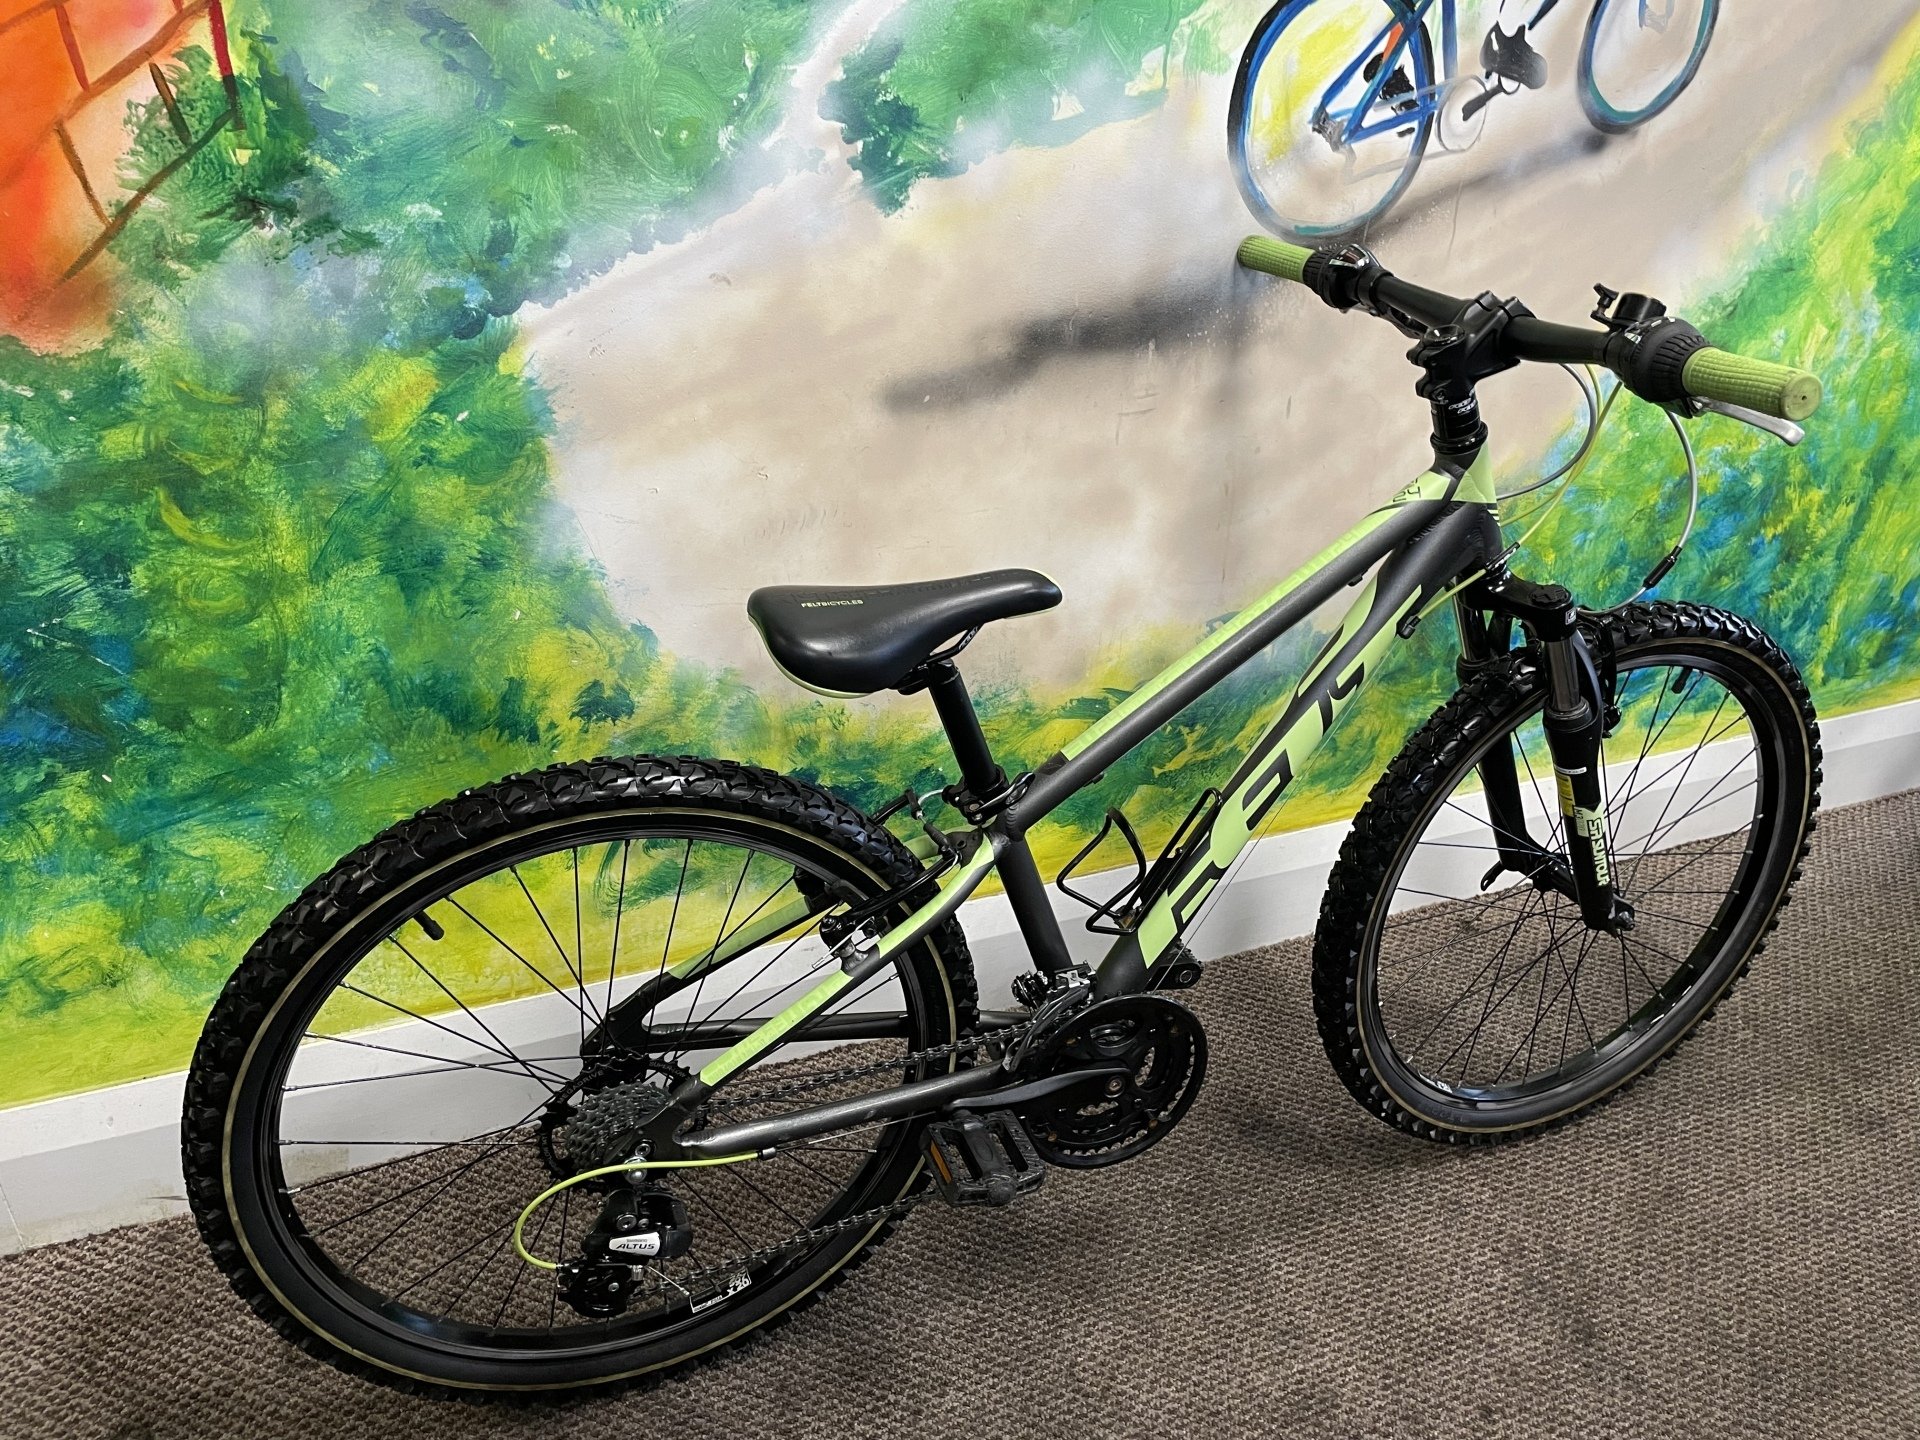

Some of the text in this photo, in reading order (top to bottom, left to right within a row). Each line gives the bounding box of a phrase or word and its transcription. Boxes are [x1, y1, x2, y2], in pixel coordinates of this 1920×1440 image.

[800, 599, 864, 608] FELTBICYCLES
[1137, 578, 1423, 969] FELT
[1591, 839, 1610, 886] SUNTOUR
